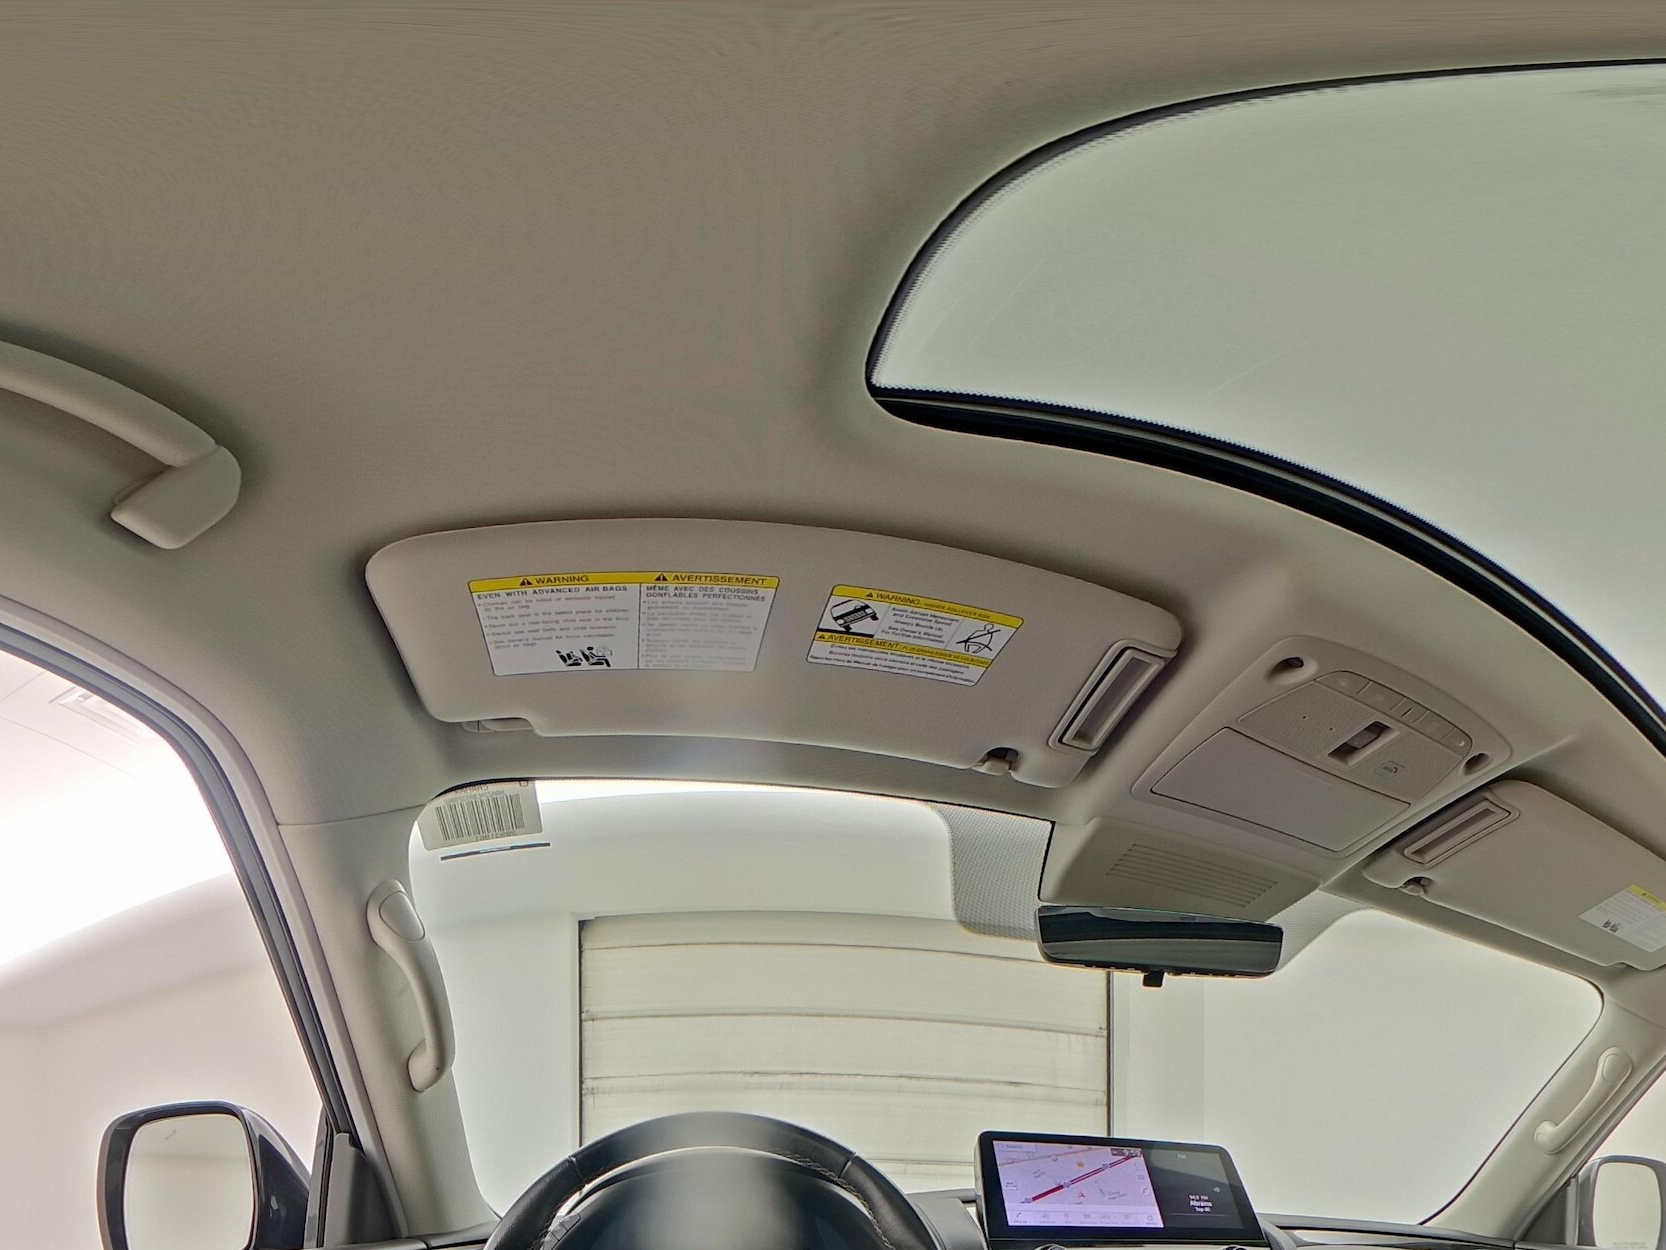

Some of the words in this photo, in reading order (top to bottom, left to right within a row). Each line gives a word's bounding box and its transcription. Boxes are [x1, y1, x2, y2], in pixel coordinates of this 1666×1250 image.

[535, 575, 589, 584] WARNING
[672, 575, 767, 585] AVERTISSEMENT
[533, 587, 580, 595] ADVANCED
[719, 587, 759, 595] COUSSINS
[875, 592, 920, 605] WARNING
[826, 634, 900, 649] AVERTISSEMENT
